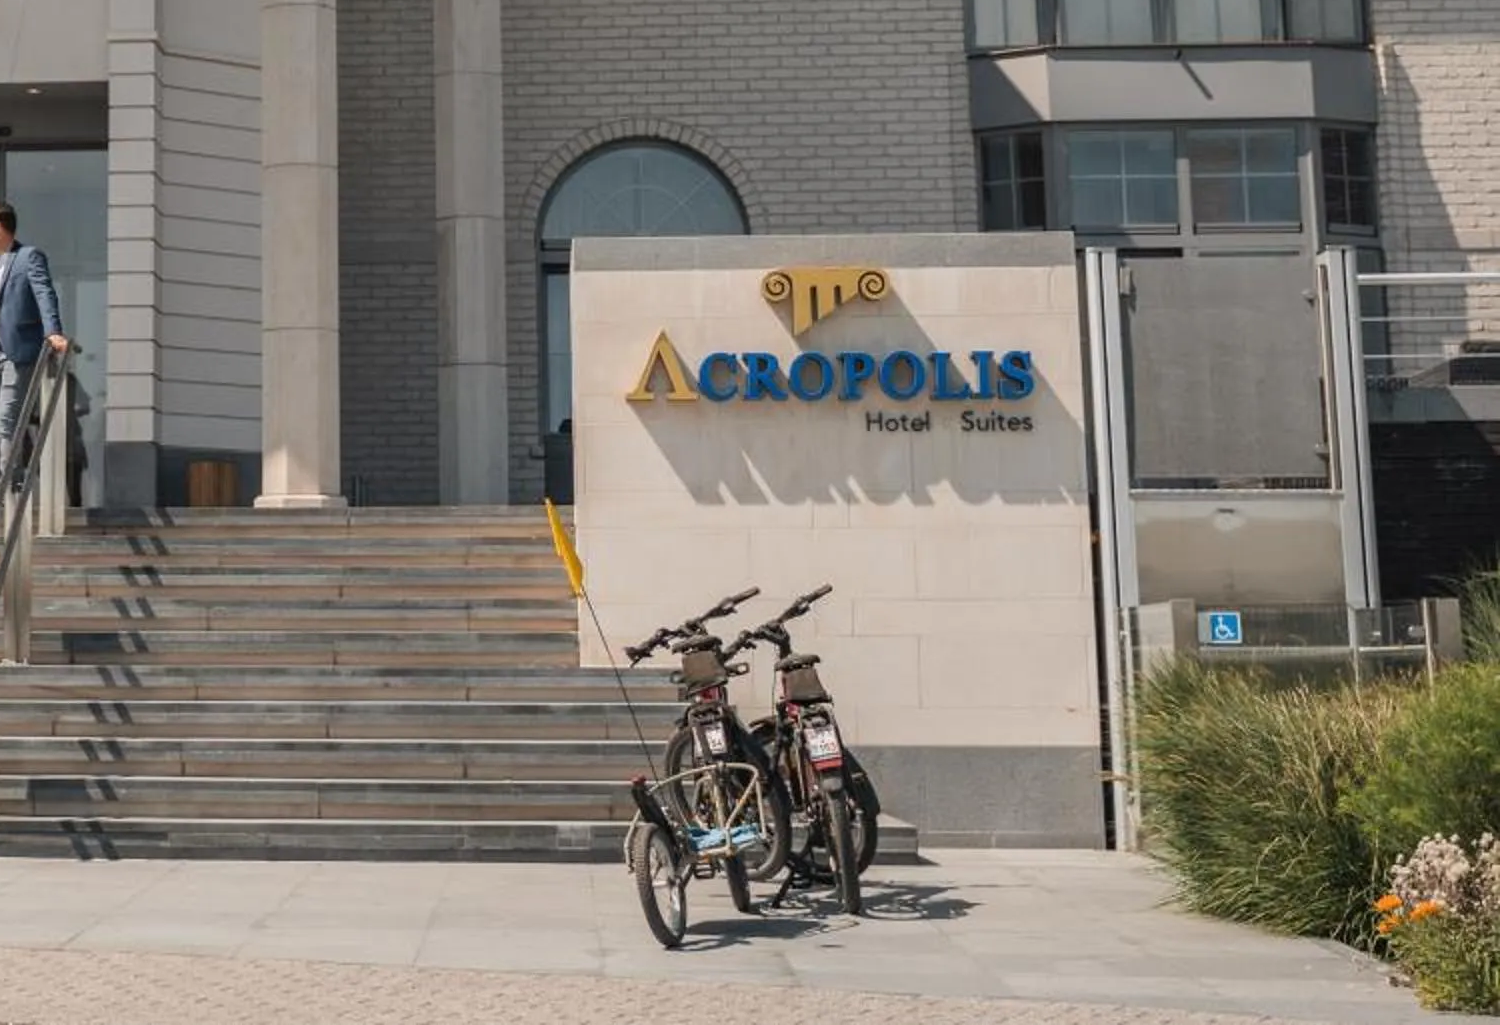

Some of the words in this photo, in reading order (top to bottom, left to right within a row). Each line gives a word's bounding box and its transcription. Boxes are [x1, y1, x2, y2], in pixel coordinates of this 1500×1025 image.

[626, 328, 1035, 402] ACROPOLIS
[866, 412, 931, 433] Hotel
[960, 412, 1033, 433] Suites
